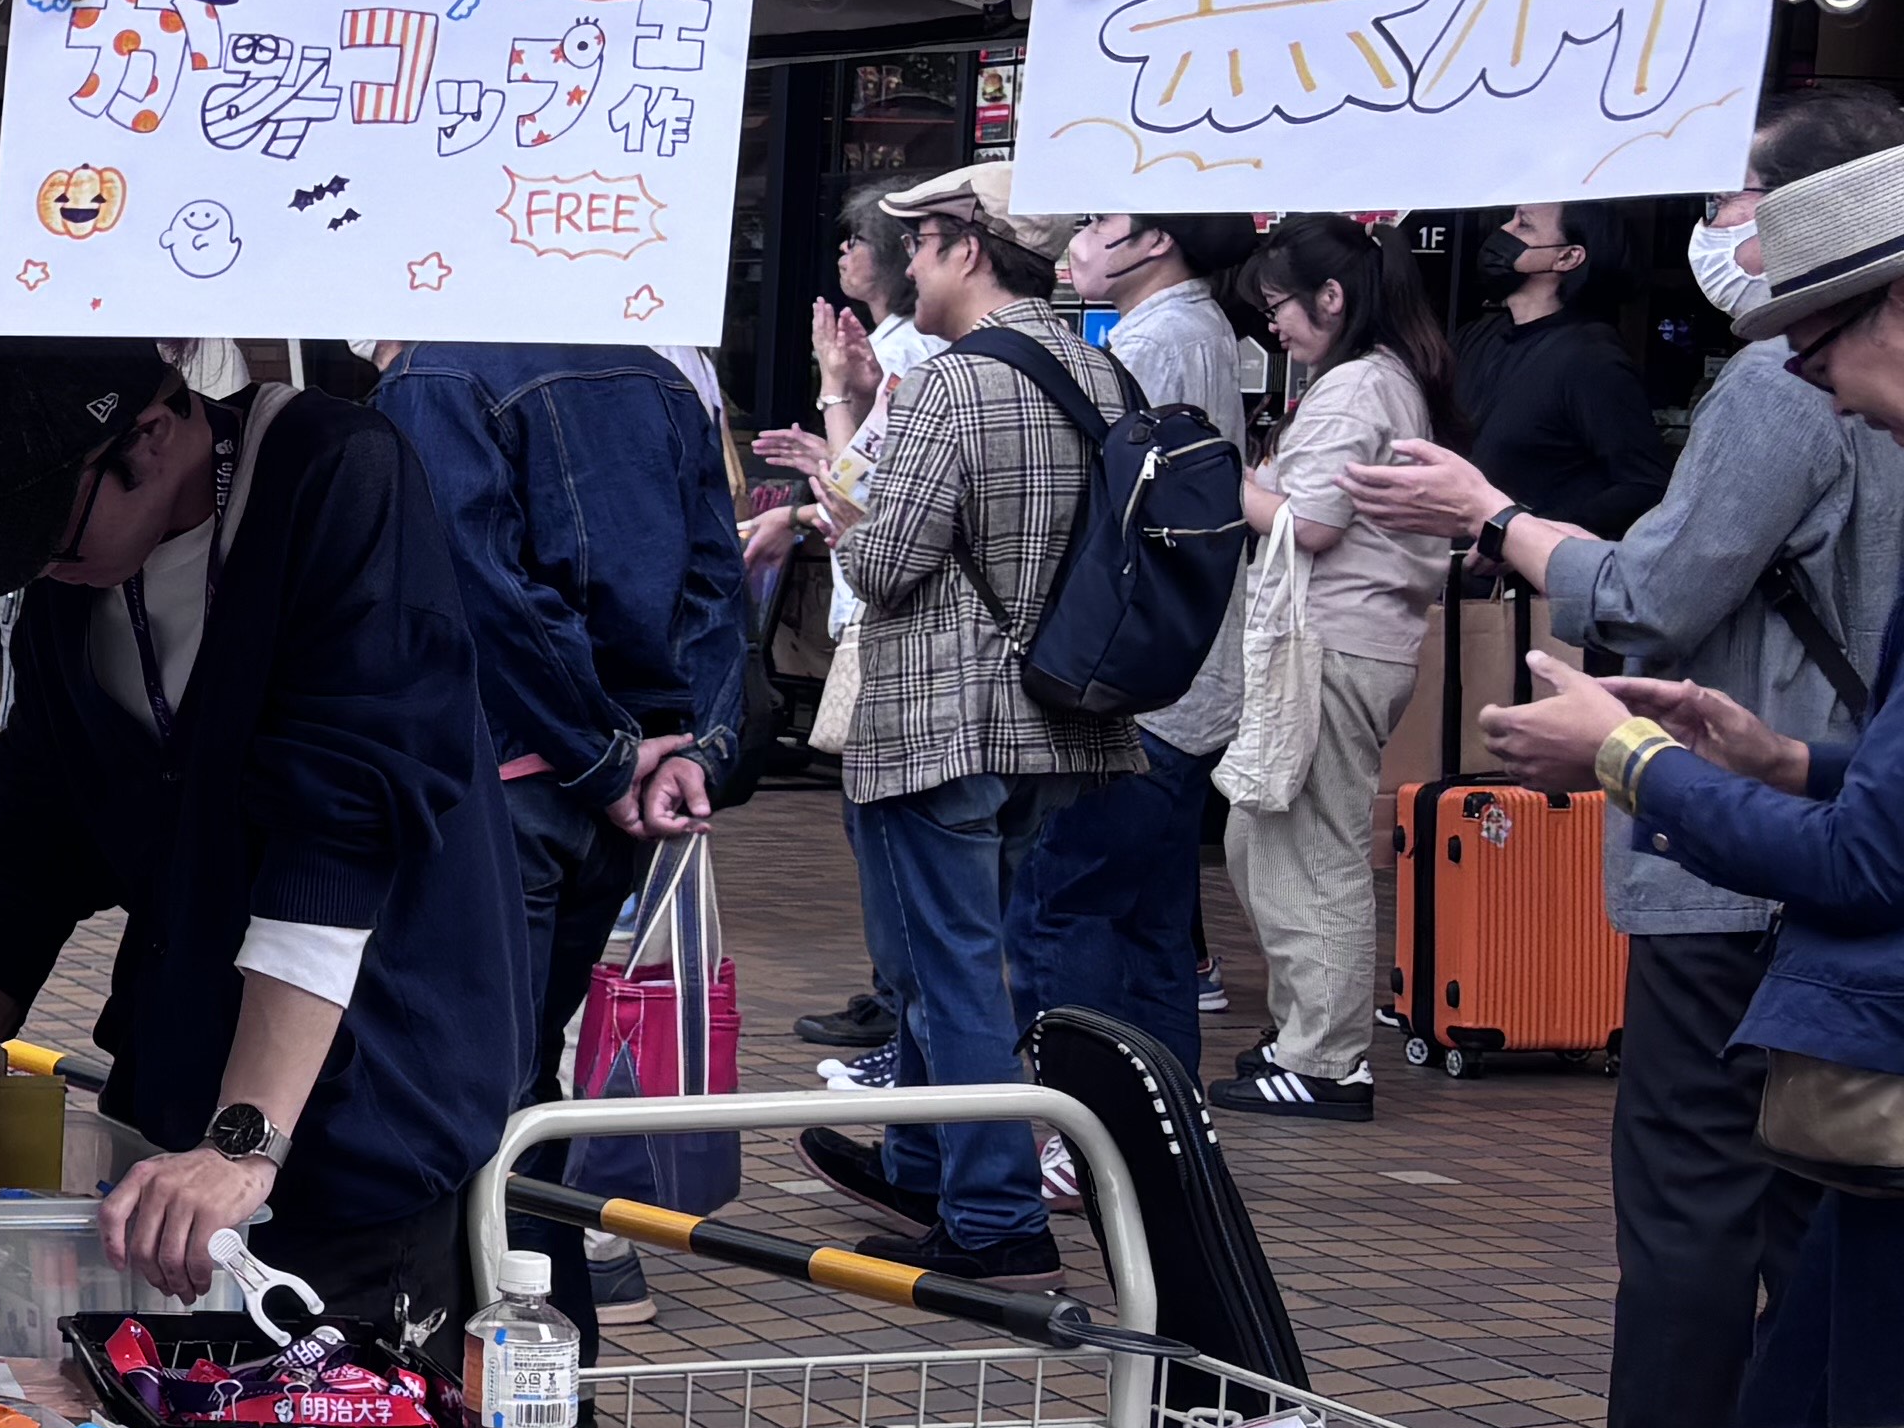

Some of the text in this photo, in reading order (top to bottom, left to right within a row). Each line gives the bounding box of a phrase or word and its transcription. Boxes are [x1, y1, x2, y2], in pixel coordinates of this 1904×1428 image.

[525, 189, 641, 236] FREE
[1419, 226, 1446, 249] 1F
[302, 1396, 393, 1424] 明治大学
